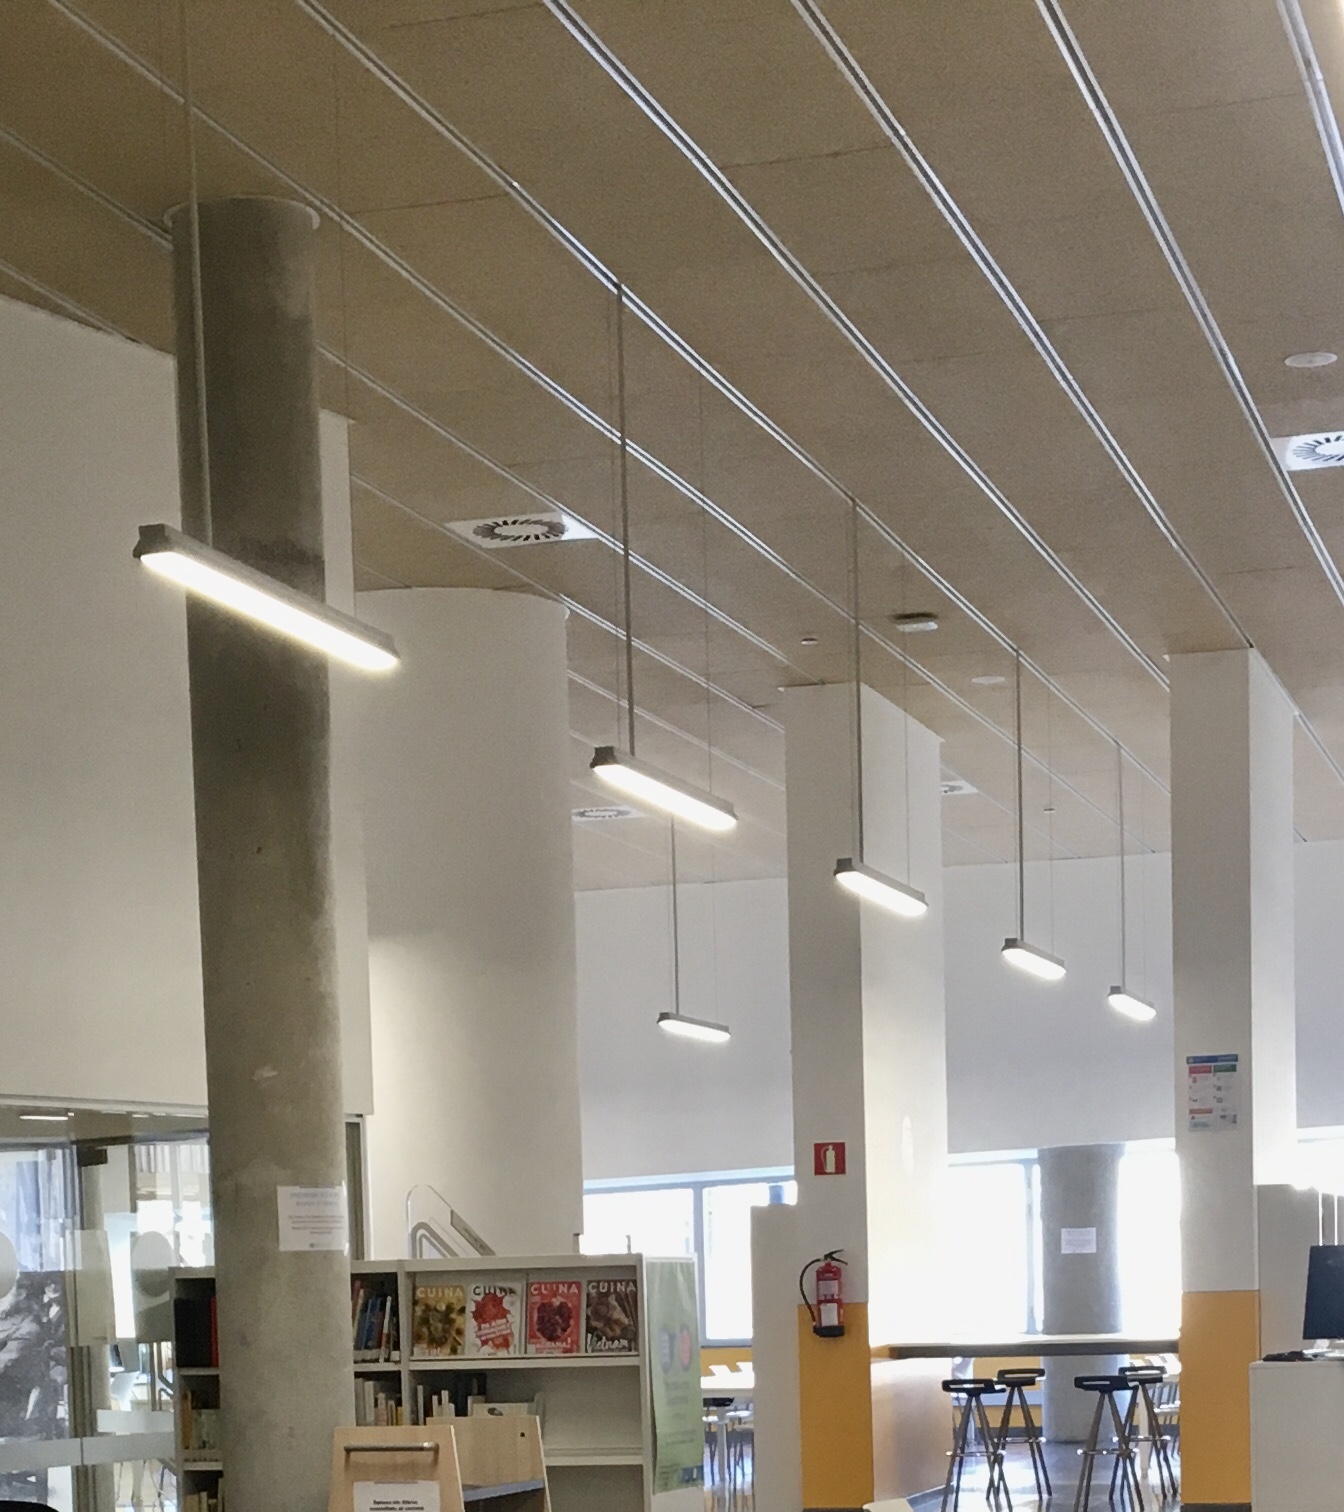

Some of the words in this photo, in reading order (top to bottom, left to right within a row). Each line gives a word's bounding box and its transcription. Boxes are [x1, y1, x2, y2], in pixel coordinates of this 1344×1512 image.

[416, 1287, 463, 1298] CUINA
[588, 1281, 636, 1293] CUINA
[587, 1333, 629, 1353] Vietnam
